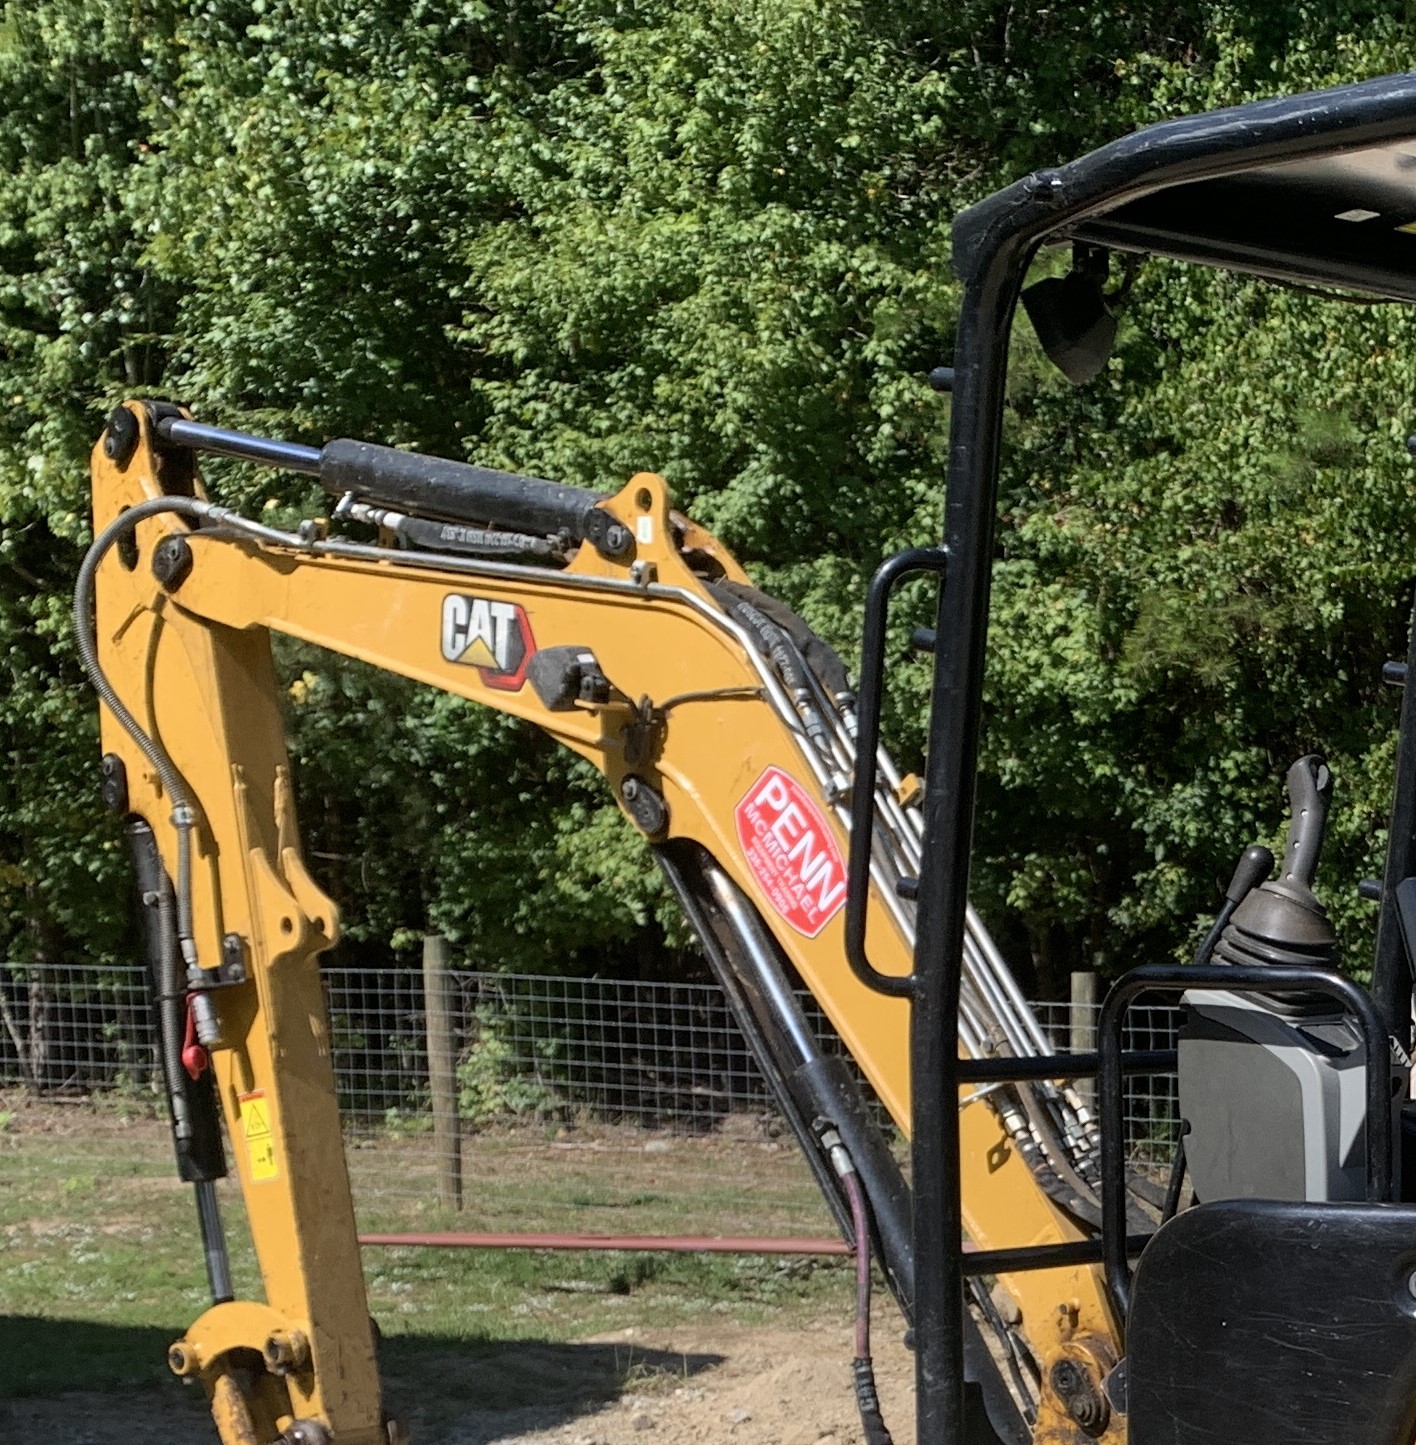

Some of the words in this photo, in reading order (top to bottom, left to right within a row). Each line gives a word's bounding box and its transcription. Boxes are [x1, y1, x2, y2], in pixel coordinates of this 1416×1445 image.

[443, 594, 516, 670] CAT
[744, 802, 819, 924] MCMICHAEL
[754, 775, 846, 912] PENN
